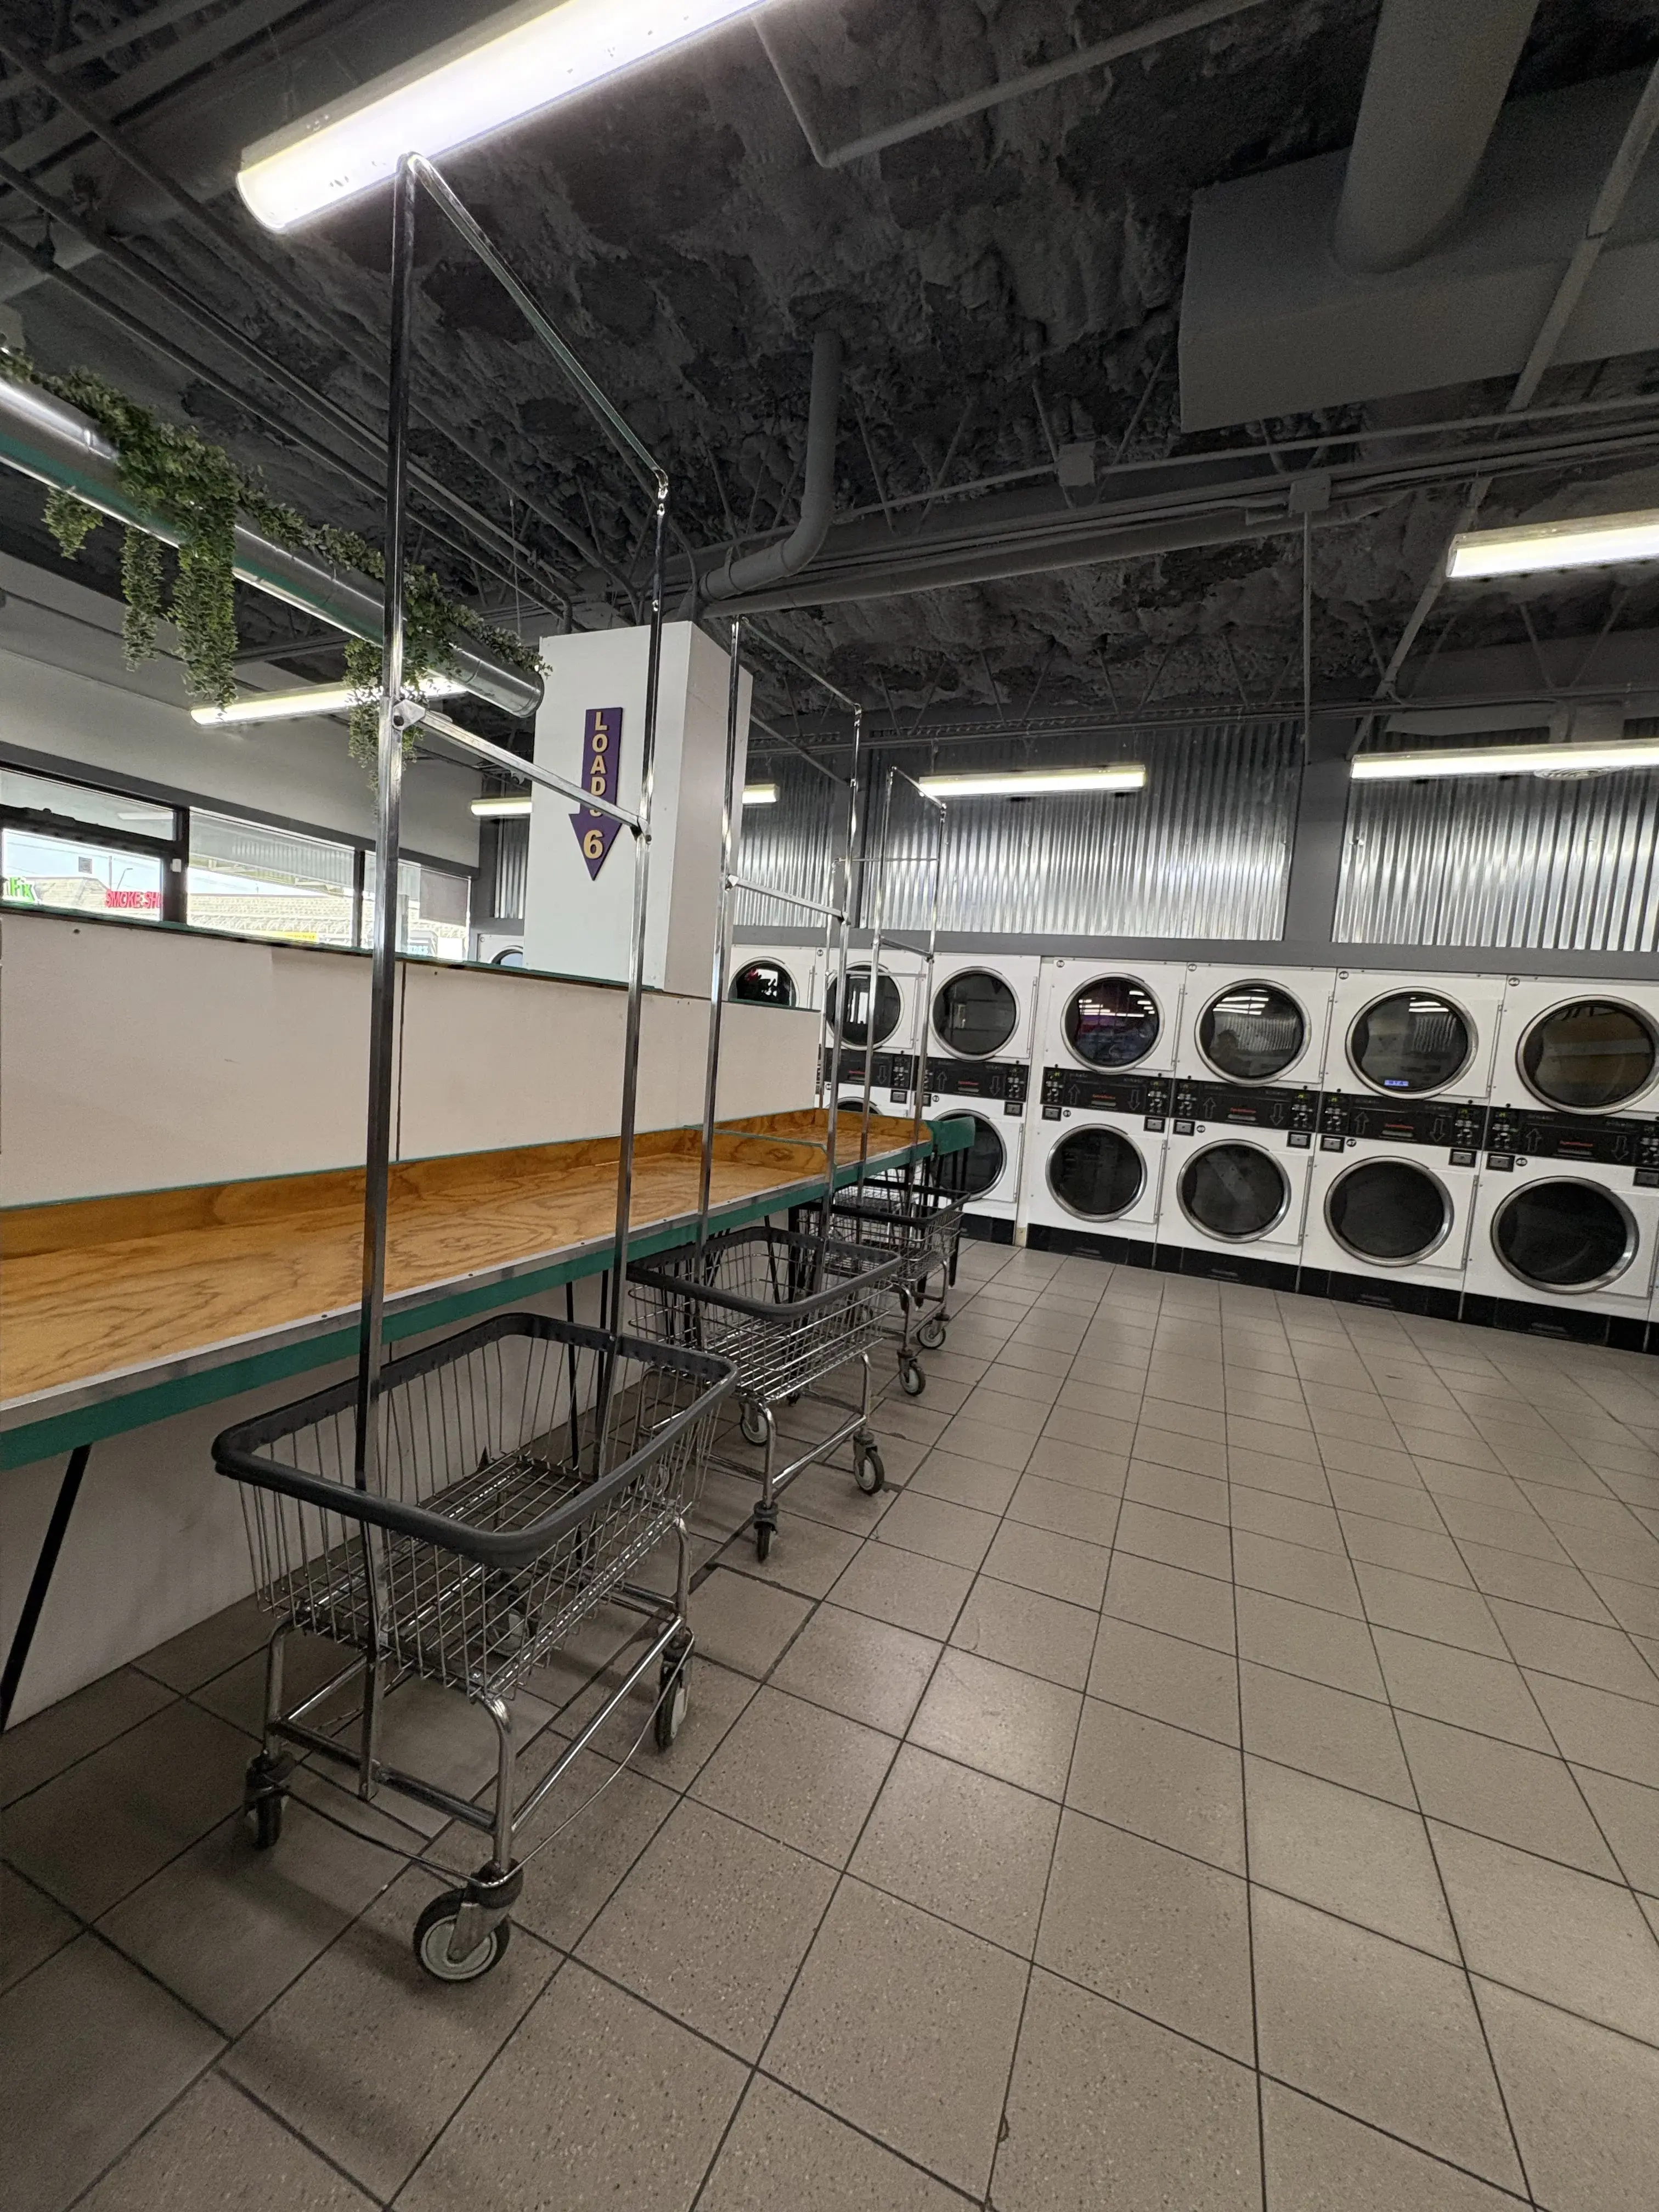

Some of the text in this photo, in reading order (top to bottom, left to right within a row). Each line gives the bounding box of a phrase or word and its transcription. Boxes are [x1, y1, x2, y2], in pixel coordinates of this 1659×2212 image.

[583, 829, 604, 860] 6
[105, 889, 162, 909] SMOKE SH
